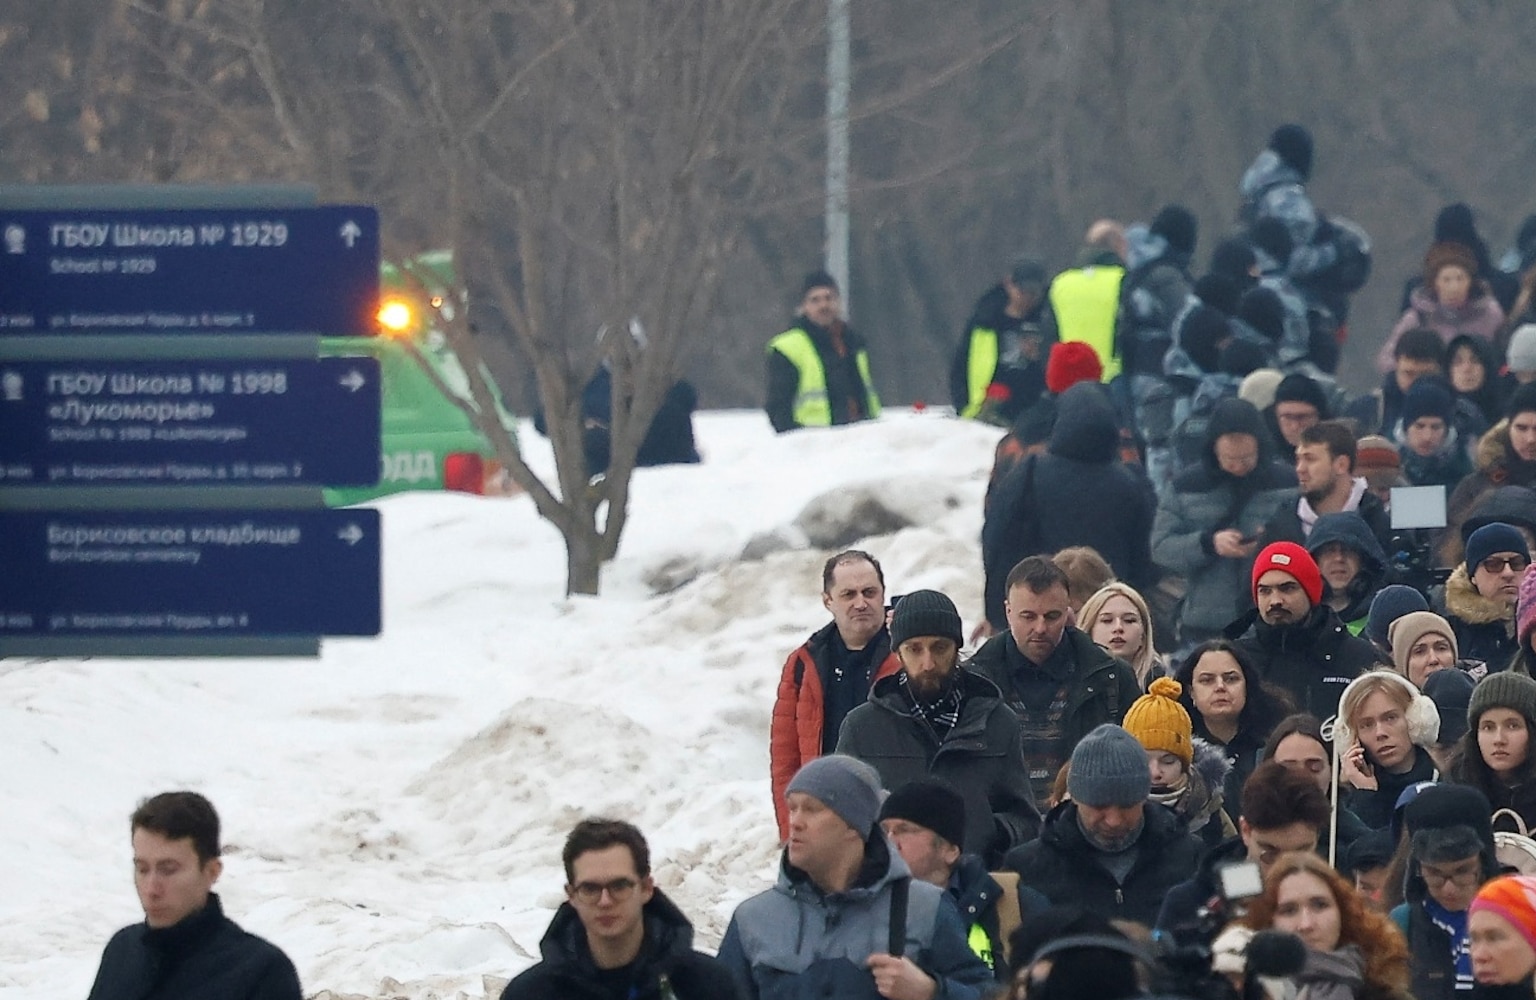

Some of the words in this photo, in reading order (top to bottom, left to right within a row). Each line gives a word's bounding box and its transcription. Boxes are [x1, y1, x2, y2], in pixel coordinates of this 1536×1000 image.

[52, 224, 108, 246] ГБОУ
[113, 224, 195, 246] Школа
[231, 223, 288, 246] 1929
[49, 373, 105, 395] ГБОУ
[111, 373, 192, 395] Школа
[198, 373, 226, 394] №
[231, 372, 288, 395] 1998
[50, 399, 215, 426] «Лукоморье»
[191, 523, 301, 547] кладбище
